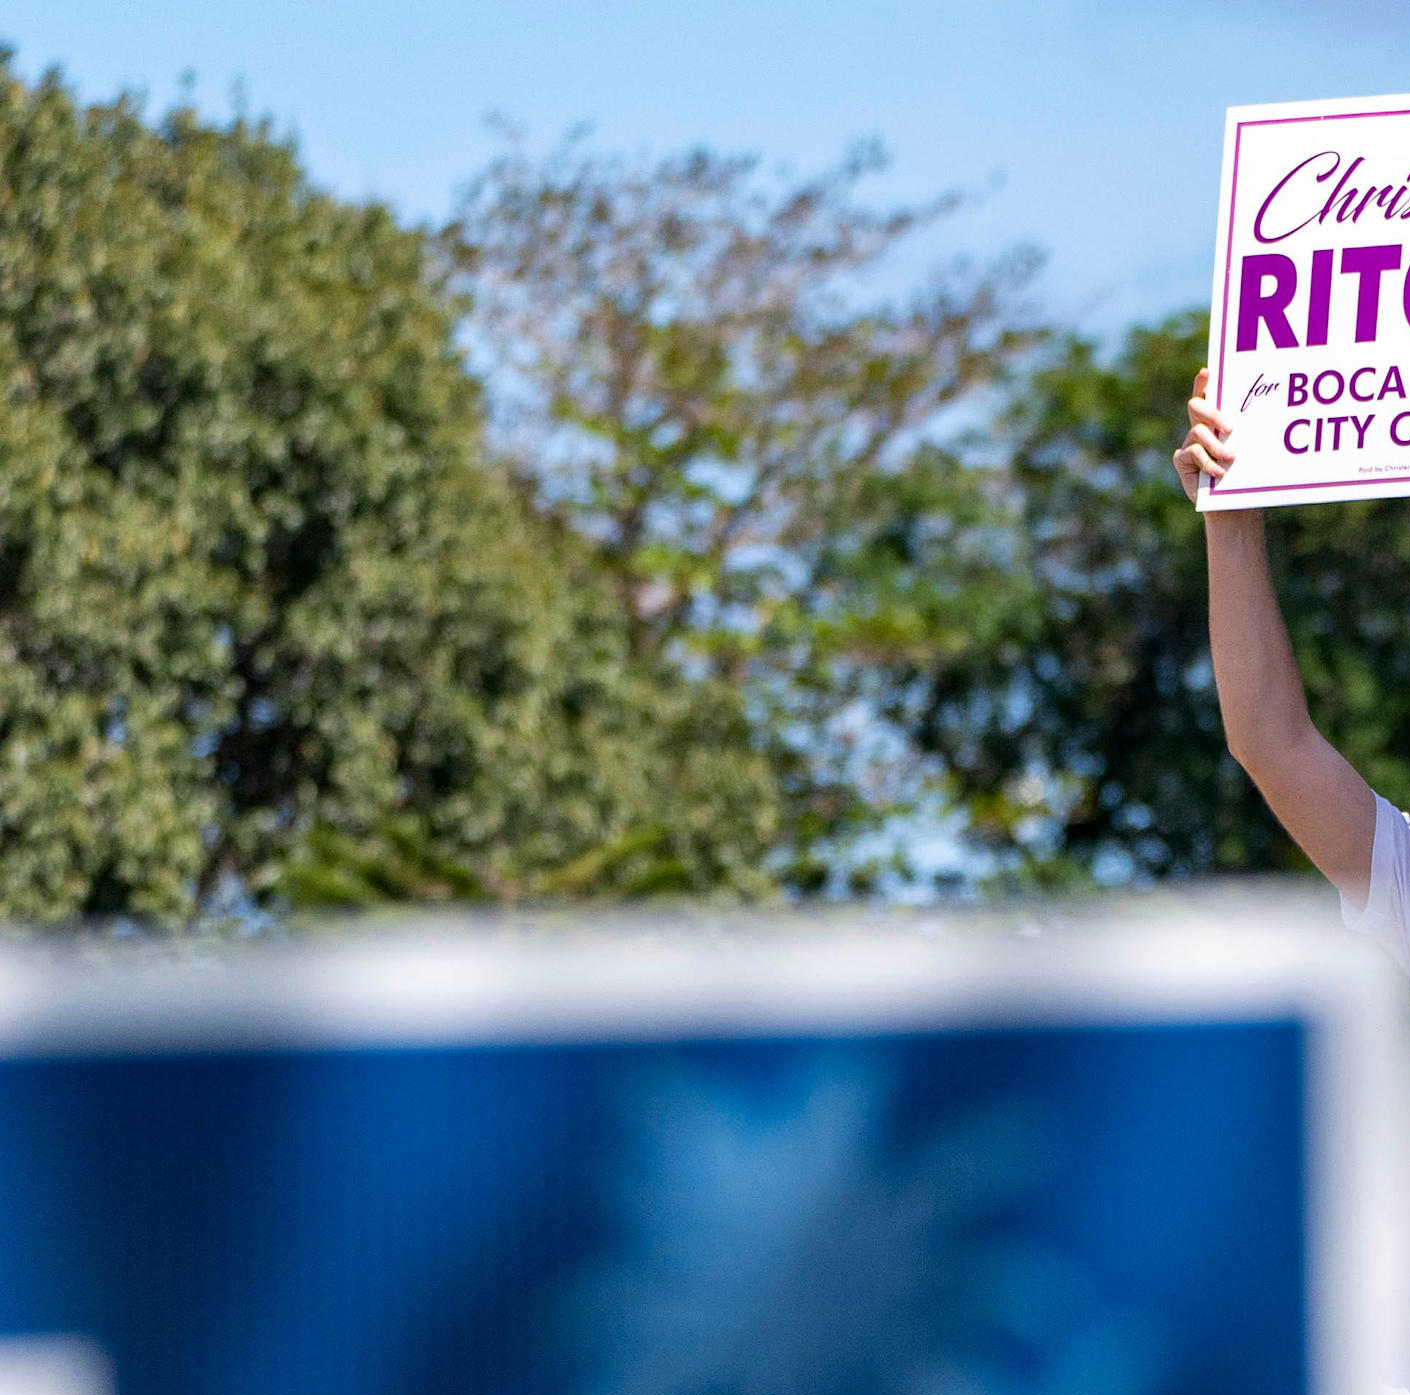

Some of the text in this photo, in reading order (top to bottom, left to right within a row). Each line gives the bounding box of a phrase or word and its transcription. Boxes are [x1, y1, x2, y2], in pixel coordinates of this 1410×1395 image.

[1241, 373, 1280, 412] for
[1287, 366, 1406, 407] BOCA
[1284, 414, 1376, 454] CITY
[1358, 466, 1373, 474] Paid
